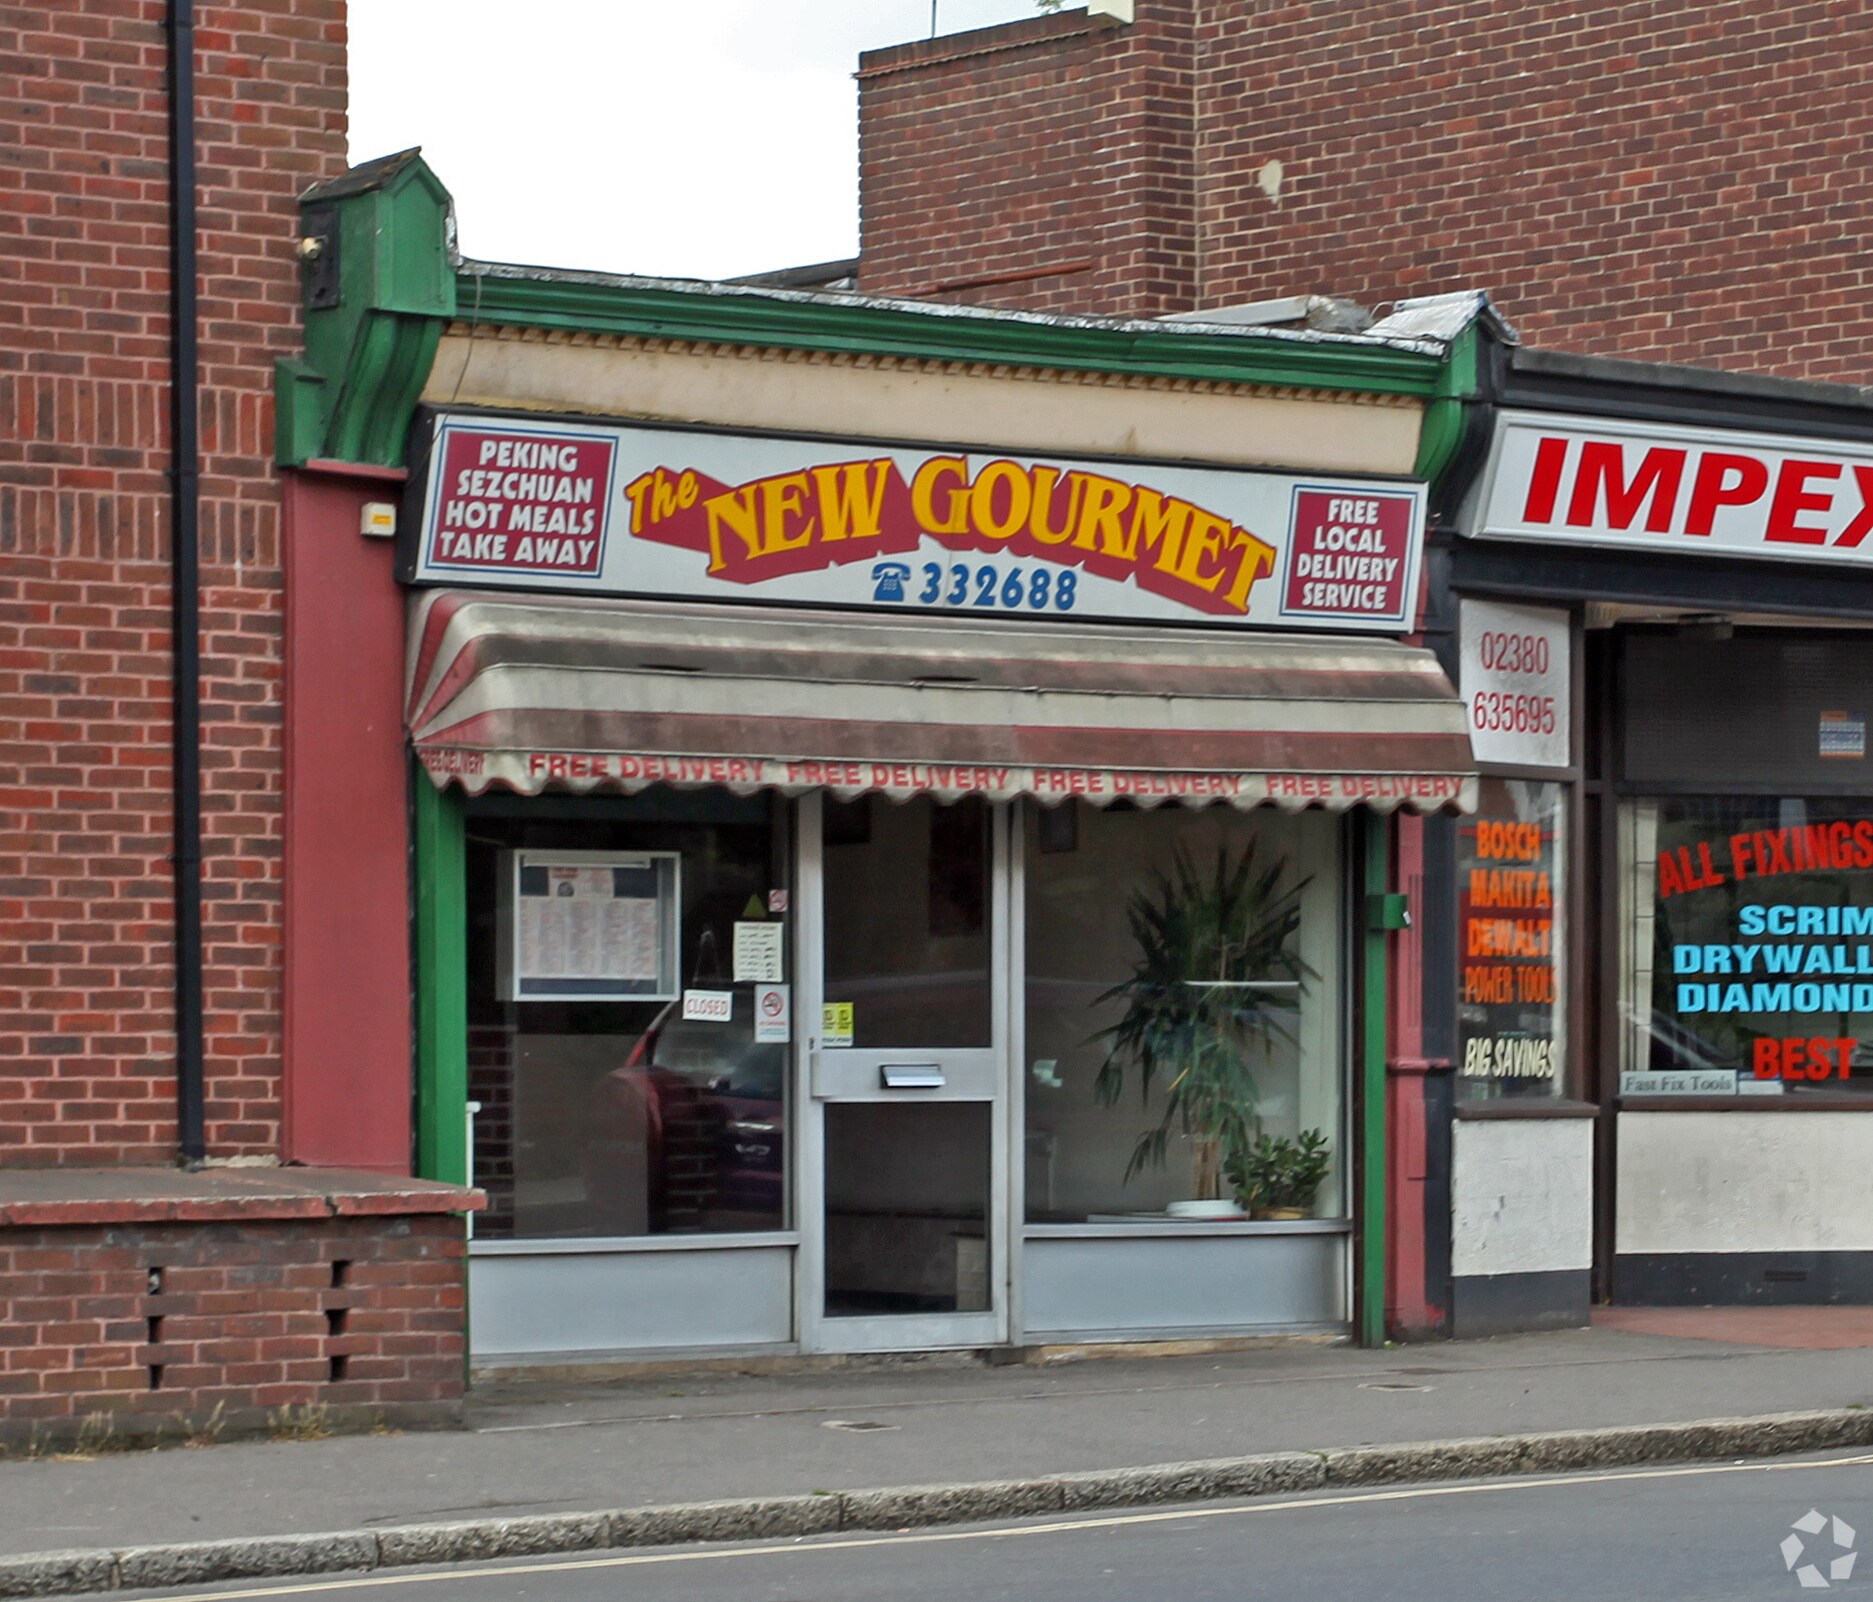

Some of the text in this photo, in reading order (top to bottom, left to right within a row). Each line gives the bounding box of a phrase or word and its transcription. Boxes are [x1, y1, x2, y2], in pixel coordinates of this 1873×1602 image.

[479, 439, 578, 472] PEKING
[456, 469, 594, 503] SEZCHUAN
[445, 500, 596, 536] HOT MEALS
[1327, 499, 1379, 524] FREE
[440, 531, 595, 566] TAKE AWAY
[625, 458, 1277, 613] The NEW GOURMET
[1313, 527, 1386, 553] LOCAL
[1297, 554, 1399, 583] DELIVERY
[919, 562, 1077, 611] 332688
[1302, 582, 1386, 610] SERVICE
[1480, 631, 1549, 674] 02380
[1474, 691, 1555, 735] 635695
[530, 753, 764, 782] FREE DELIVERY
[787, 761, 1009, 790] FREE DELIVERY
[1033, 769, 1243, 796] FREE DELIVERY
[1266, 774, 1464, 799] FREE DELIVERY
[1477, 820, 1541, 860] BOSCH
[1658, 820, 1873, 898] ALL FIXINGS
[1470, 869, 1551, 908] MAKITA
[1739, 904, 1873, 936] SCRIM
[1468, 918, 1552, 957] DEWALT
[1673, 944, 1873, 974] DRYWALL
[1465, 966, 1513, 1003] POWER
[1677, 982, 1873, 1013] DIAMOND
[686, 998, 729, 1016] CLOSED
[1464, 1037, 1557, 1079] BIG SAVINGS
[1753, 1037, 1859, 1080] BEST
[1661, 1075, 1685, 1091] Fix
